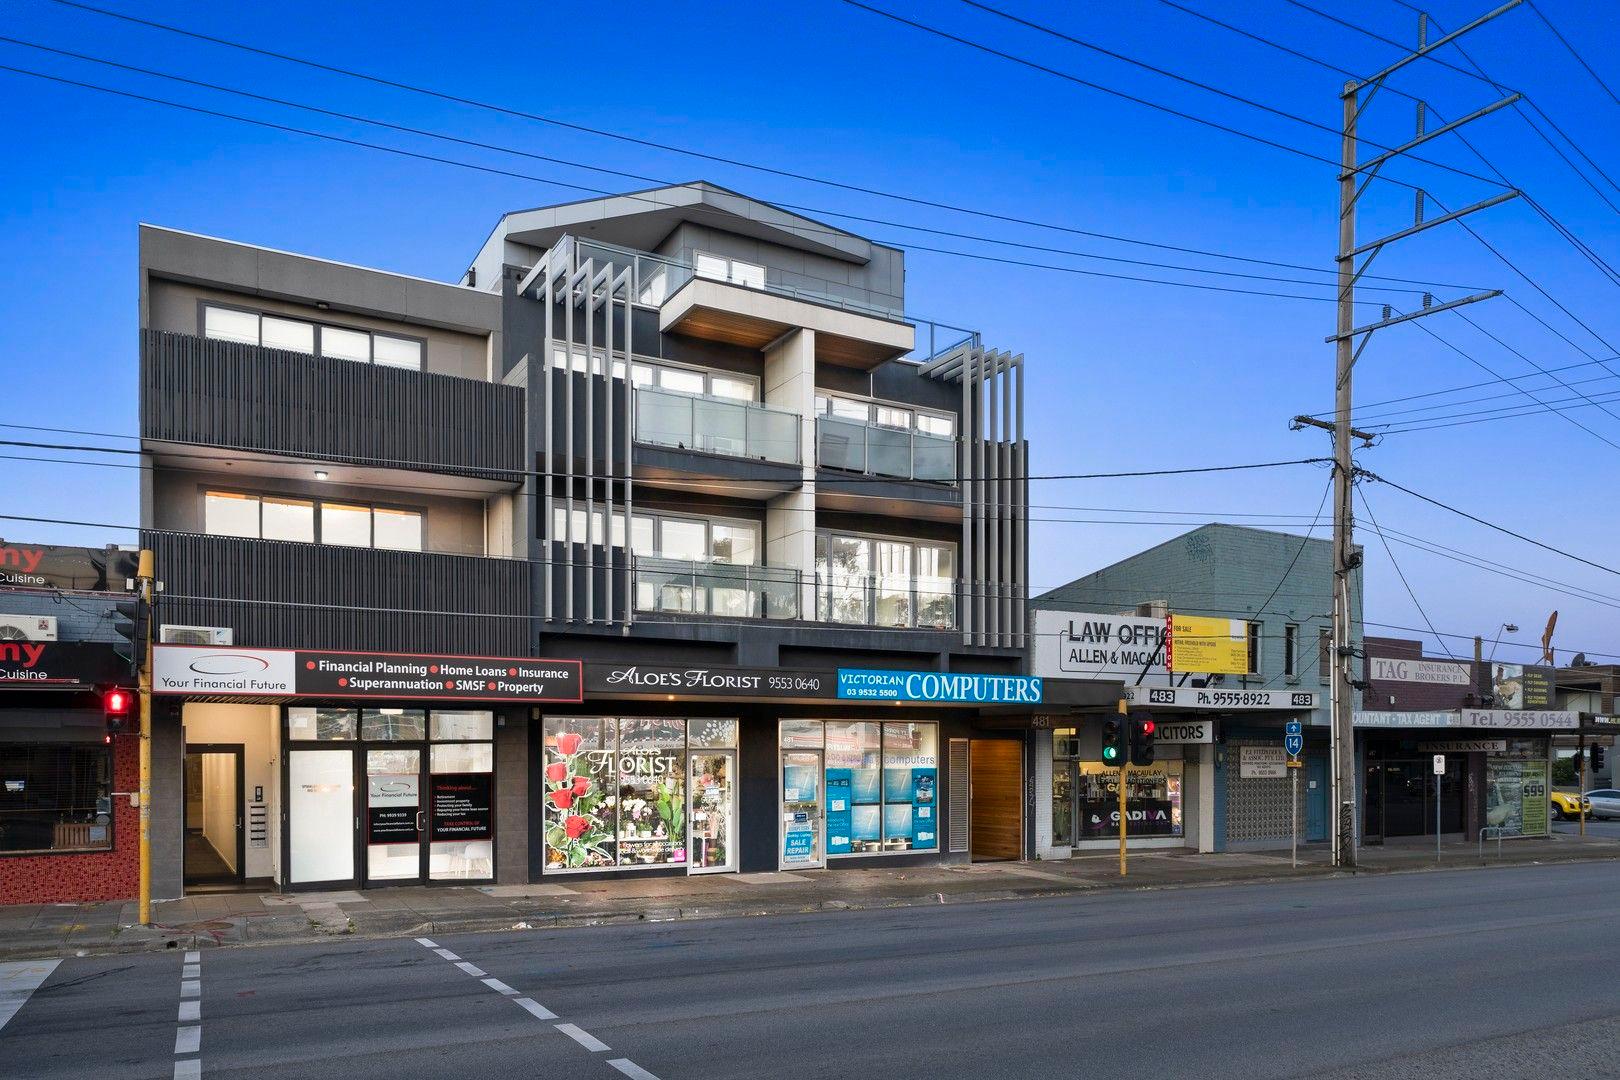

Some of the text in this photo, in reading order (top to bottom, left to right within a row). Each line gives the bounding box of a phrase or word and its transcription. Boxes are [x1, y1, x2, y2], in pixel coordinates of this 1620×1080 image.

[1068, 619, 1111, 643] LAW
[1069, 649, 1107, 663] ALLEN
[1110, 651, 1118, 665] &
[318, 660, 569, 679] Financial Planning Home Loans Insurance
[1376, 660, 1461, 680] TAG INSURANCE
[162, 677, 287, 691] Your Financial Future
[684, 670, 762, 689] FLORIST
[768, 676, 792, 690] 9553
[795, 678, 820, 690] 0640
[1415, 672, 1451, 682] BROKERS
[350, 677, 544, 694] Superannuation SMSF Property
[840, 673, 1041, 702] VICTORIAN COMPUTERS
[858, 688, 878, 696] 9532
[878, 689, 898, 697] 5500
[1151, 690, 1174, 702] 483
[1198, 692, 1211, 706] Ph.
[1292, 694, 1312, 706] 483
[1032, 715, 1050, 726] 481
[1396, 713, 1414, 724] TAX
[1414, 714, 1440, 725] AGENT
[1470, 712, 1498, 727] Tel.
[1503, 712, 1536, 728] 9555
[1540, 712, 1573, 727] 0544
[1289, 738, 1298, 748] 14
[1426, 742, 1499, 751] INSURANCE
[588, 750, 676, 774] FLORIST
[884, 755, 935, 764] computers
[786, 847, 809, 855] REPAIR
